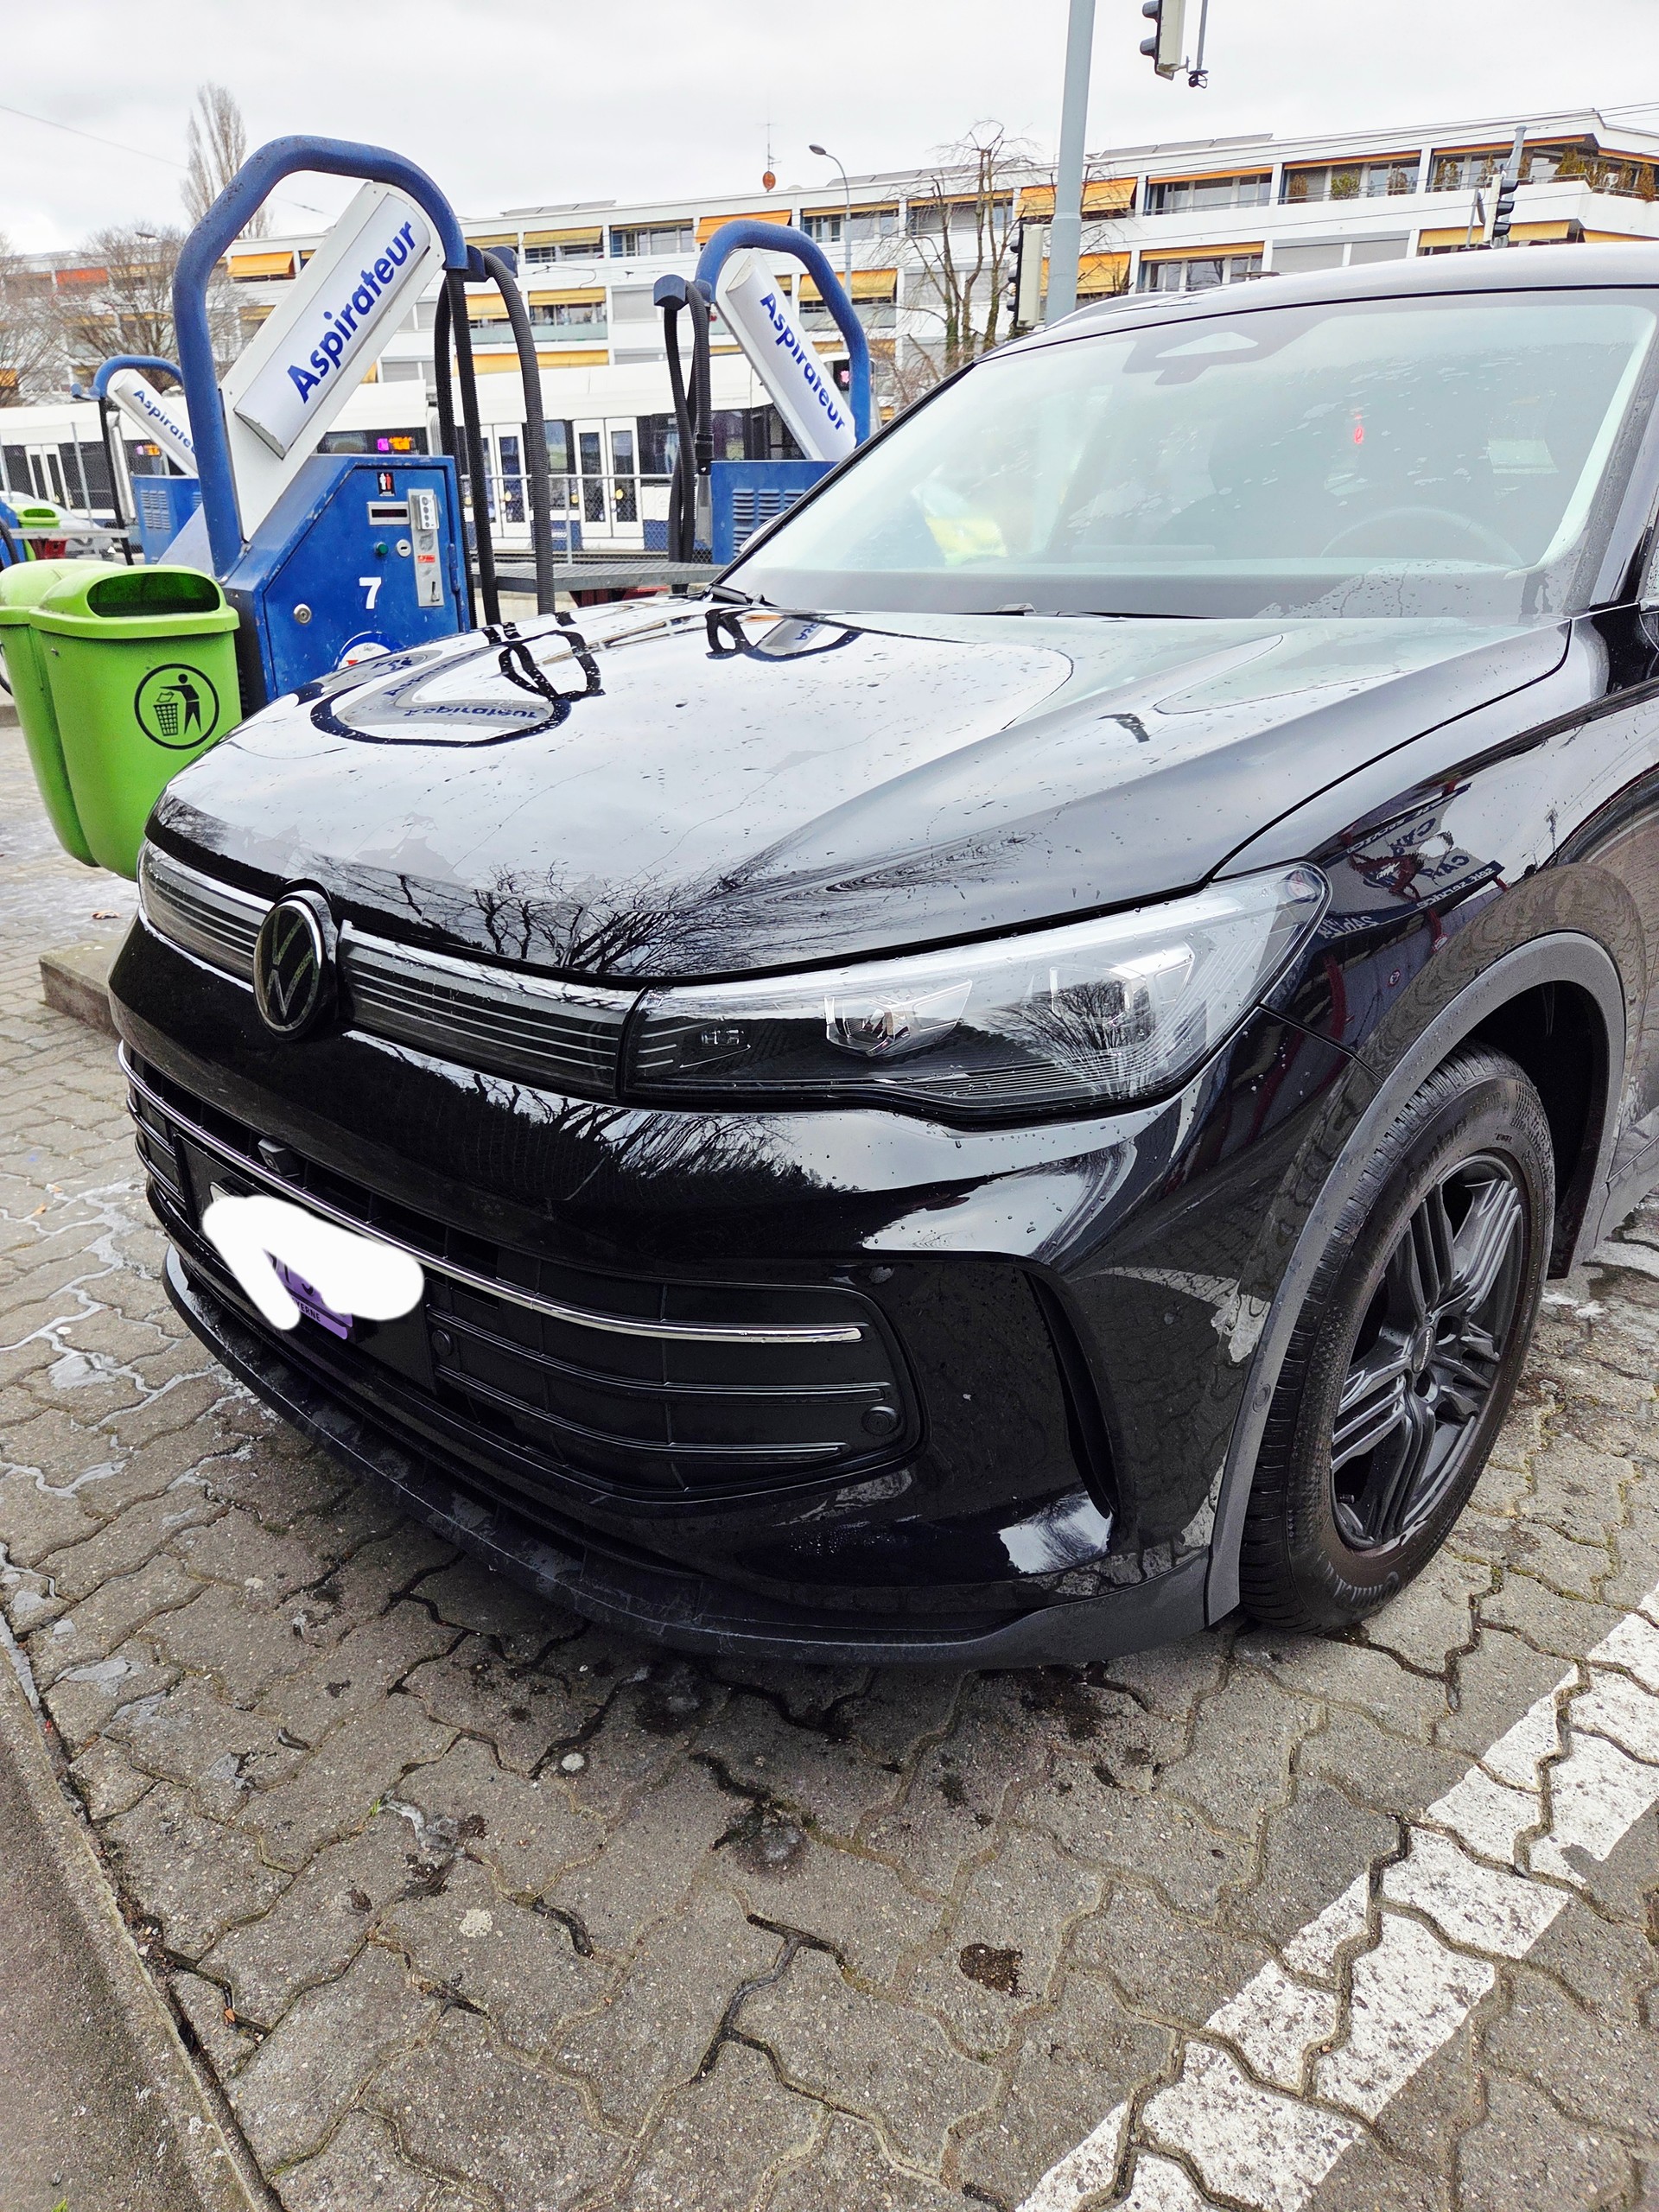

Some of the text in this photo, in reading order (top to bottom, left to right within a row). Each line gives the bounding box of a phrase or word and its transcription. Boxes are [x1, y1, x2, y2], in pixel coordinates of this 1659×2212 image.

[287, 221, 416, 404] Aspirateur
[760, 292, 845, 430] Aspirateur
[359, 576, 382, 610] 7
